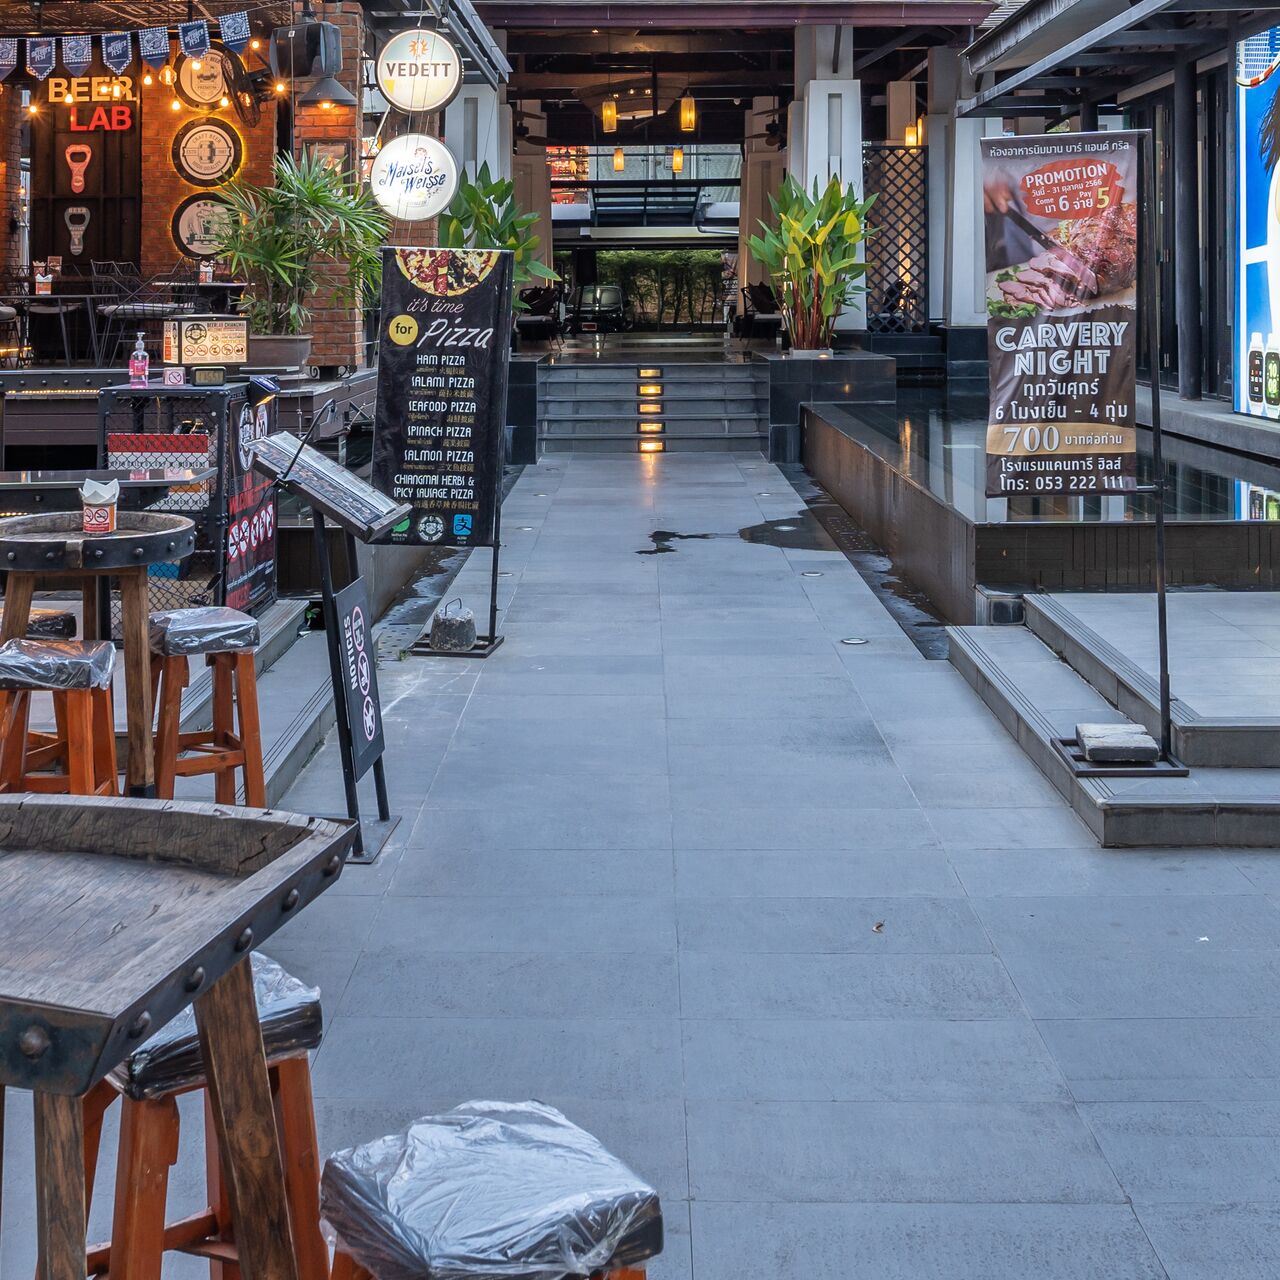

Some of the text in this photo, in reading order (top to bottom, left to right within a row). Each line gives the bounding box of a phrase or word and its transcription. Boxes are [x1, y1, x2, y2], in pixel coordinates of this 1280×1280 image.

[386, 63, 451, 77] VEDETT
[49, 76, 137, 102] BEER
[70, 106, 132, 131] LAB
[990, 144, 1063, 157] ห้องอาหารนิมมาน
[1066, 142, 1082, 153] บาร์
[1085, 141, 1109, 151] แอนด์
[379, 157, 432, 187] Maisel's
[1026, 163, 1108, 188] PROMOTION
[401, 173, 446, 193] Weisse
[1053, 186, 1060, 194] 31
[1036, 190, 1092, 206] Come Pay
[1045, 187, 1110, 214] มา 6 จ่าย 5
[407, 298, 464, 313] it's time
[396, 317, 494, 348] for Pizza
[995, 322, 1129, 352] CARVERY
[417, 355, 465, 366] HAM PIZZA
[1014, 349, 1111, 376] NIGHT
[412, 376, 475, 388] SALAMI PIZZA
[1024, 378, 1100, 401] ทุกวันศุกร์
[409, 401, 476, 412] SEAFOOD PIZZA
[996, 406, 1004, 419] 6
[1011, 401, 1067, 419] โมงเย็น
[1090, 403, 1099, 418] 4
[1106, 400, 1128, 422] ทุ่ม
[408, 426, 471, 437] SPINACH PIZZA
[1004, 426, 1122, 452] 700 บาทต่อท่าน
[405, 450, 474, 462] SALMON PIZZA
[1001, 457, 1122, 472] โรงแรมแคนทารี ฮิลส์
[394, 474, 474, 486] CHIANGMAI HERBS &
[1000, 474, 1123, 490] โทร: 053 222 111
[394, 487, 473, 499] SPICY SAUSAGE PIZZA
[344, 615, 358, 690] NOTICES
